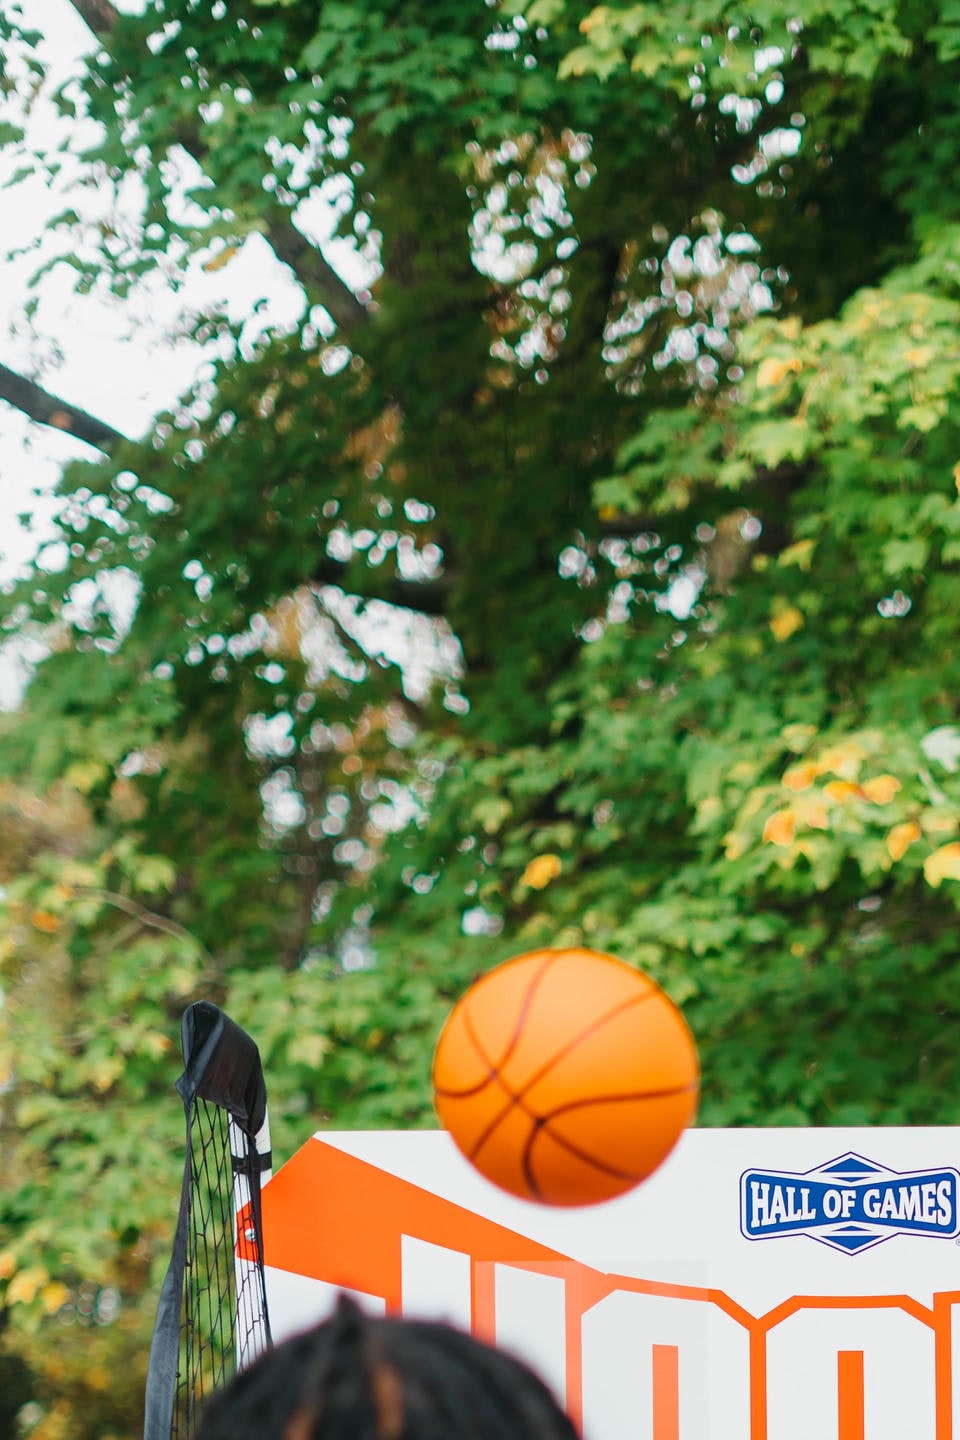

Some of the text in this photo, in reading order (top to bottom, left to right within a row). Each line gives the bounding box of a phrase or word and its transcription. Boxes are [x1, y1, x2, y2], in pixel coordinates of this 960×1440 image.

[750, 1180, 952, 1229] HALL OF GAMES
